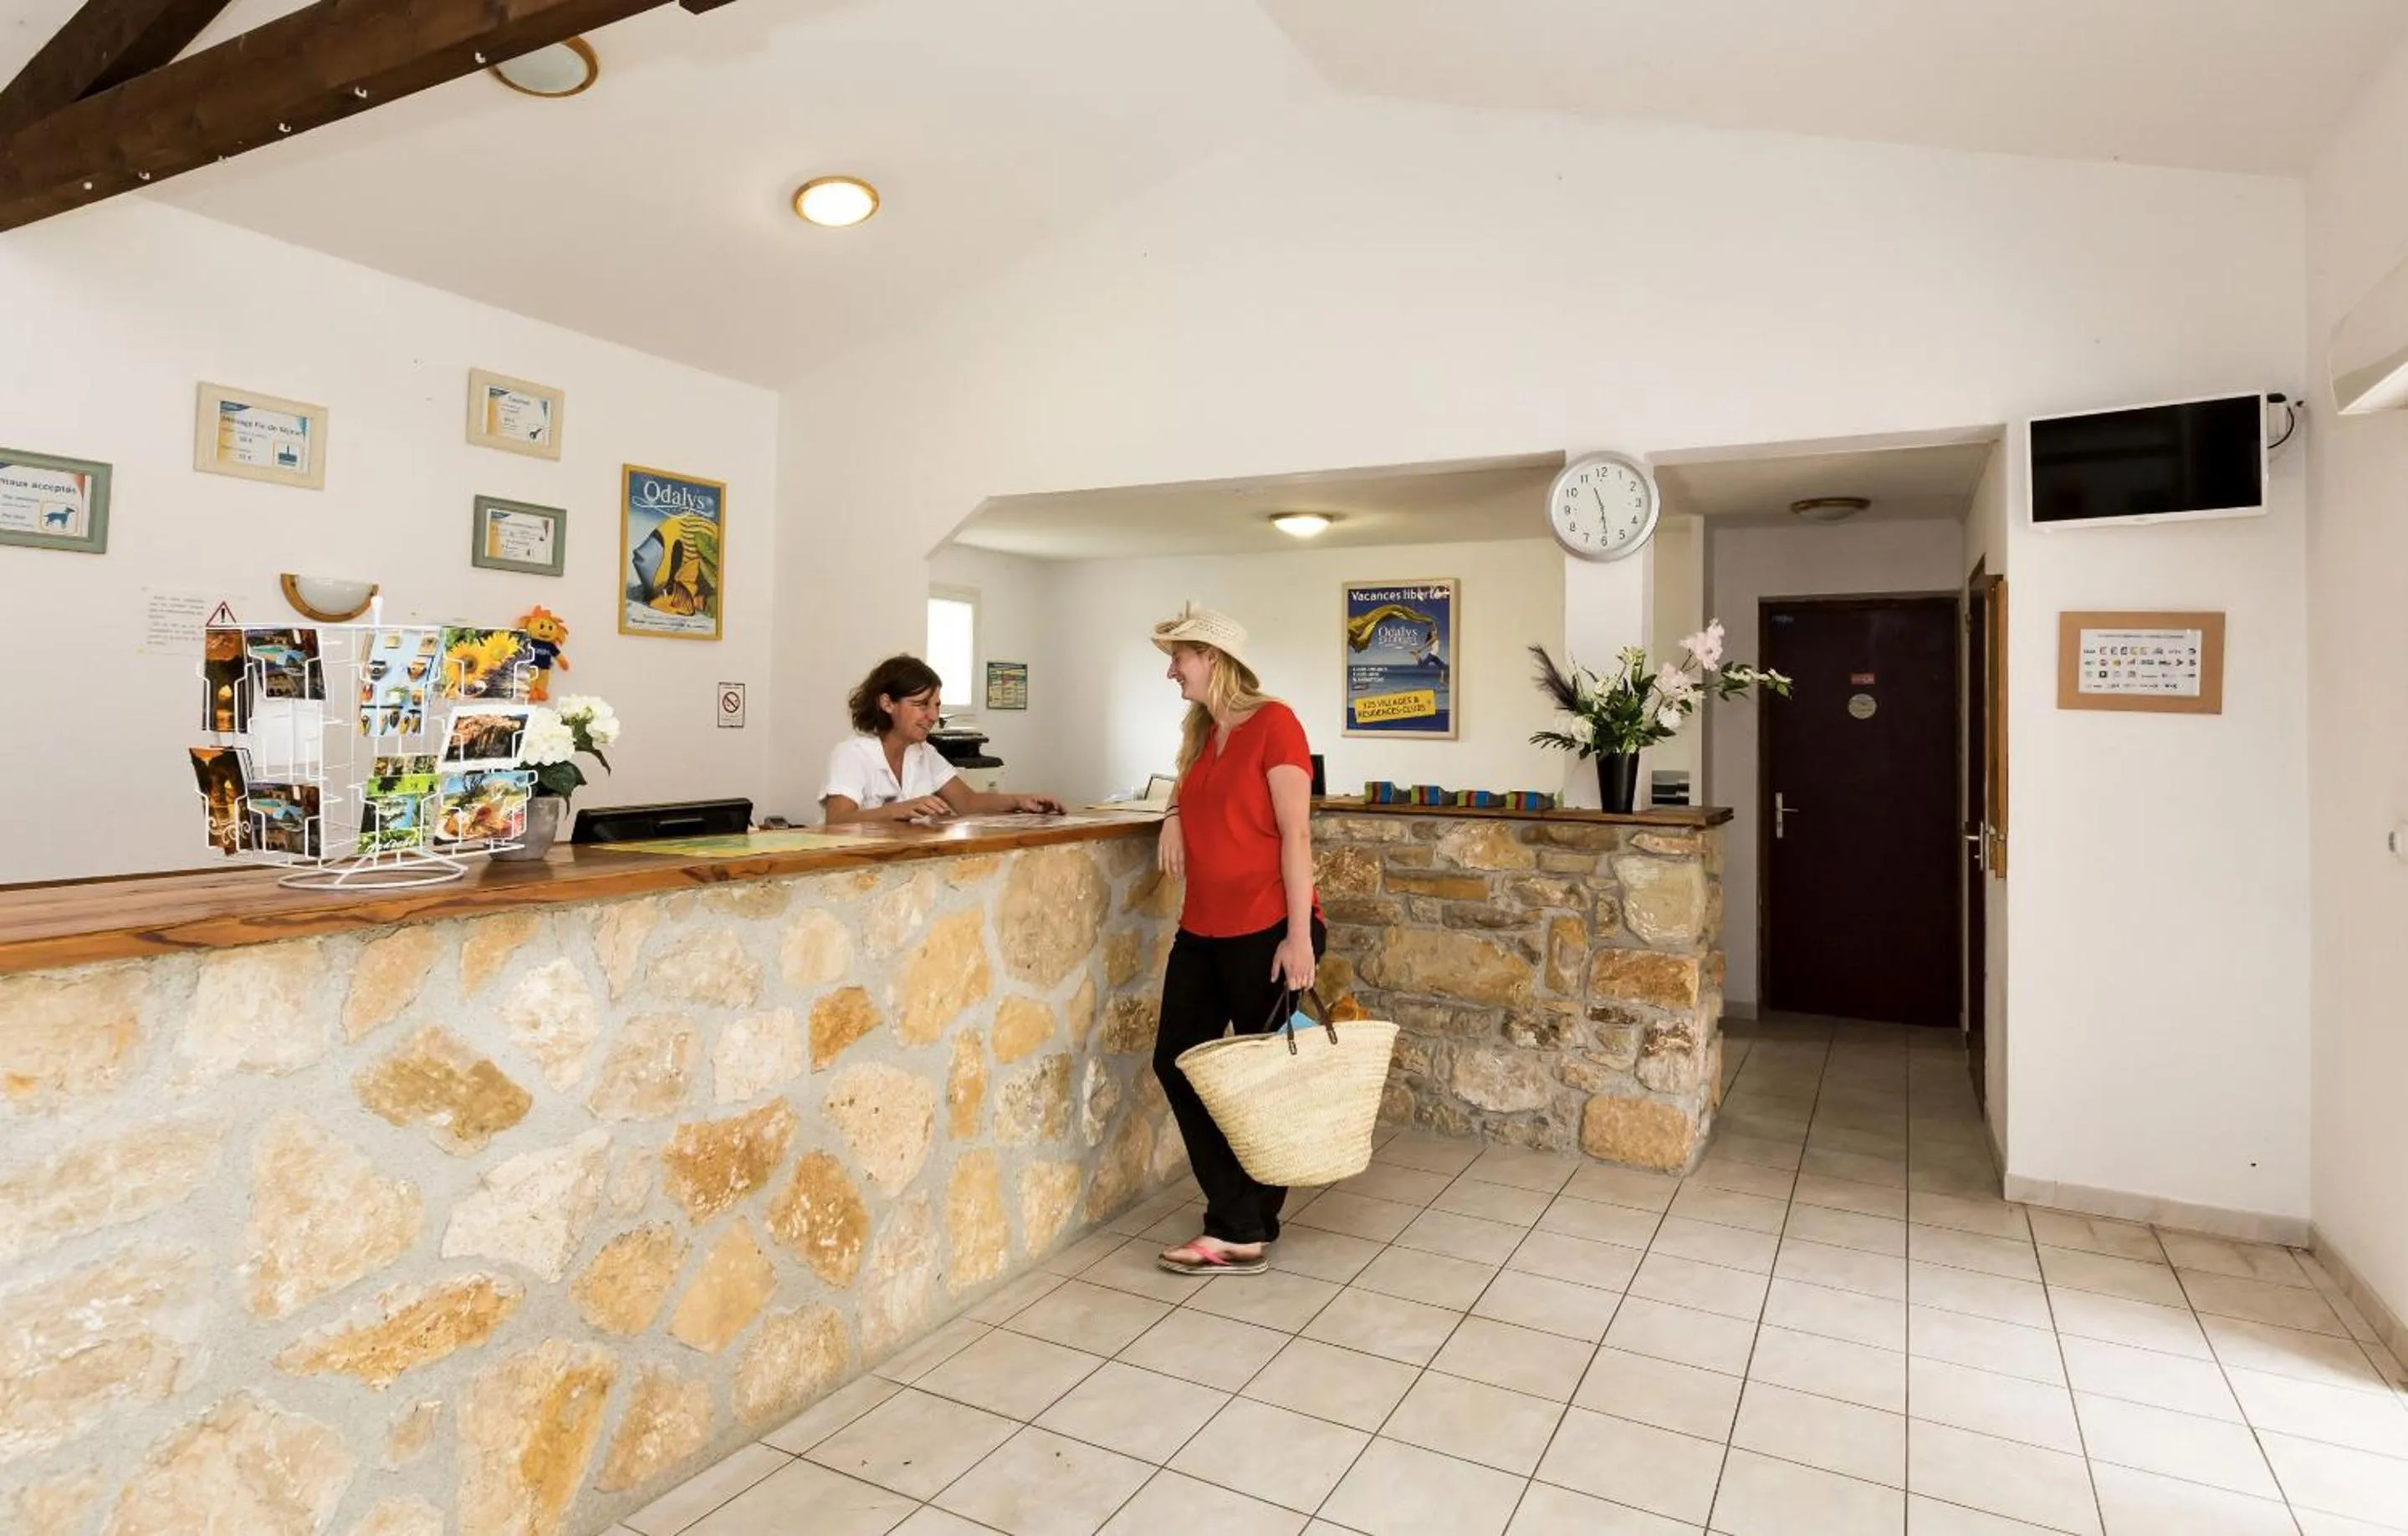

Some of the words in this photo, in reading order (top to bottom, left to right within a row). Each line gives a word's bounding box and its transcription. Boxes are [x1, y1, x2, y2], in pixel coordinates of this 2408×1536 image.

[1595, 467, 1608, 477] 12
[1618, 469, 1623, 480] 1
[1581, 474, 1589, 484] 11
[1630, 481, 1637, 492] 2
[643, 481, 705, 512] Odalys
[1566, 487, 1578, 498] 10
[1634, 498, 1641, 508] 3
[1563, 505, 1571, 515] 9
[1631, 515, 1638, 524] 4
[1569, 521, 1576, 532] 8
[1583, 532, 1590, 542] 7
[1619, 529, 1625, 539] 5
[1601, 536, 1608, 547] 6
[1351, 590, 1402, 601] Vacances
